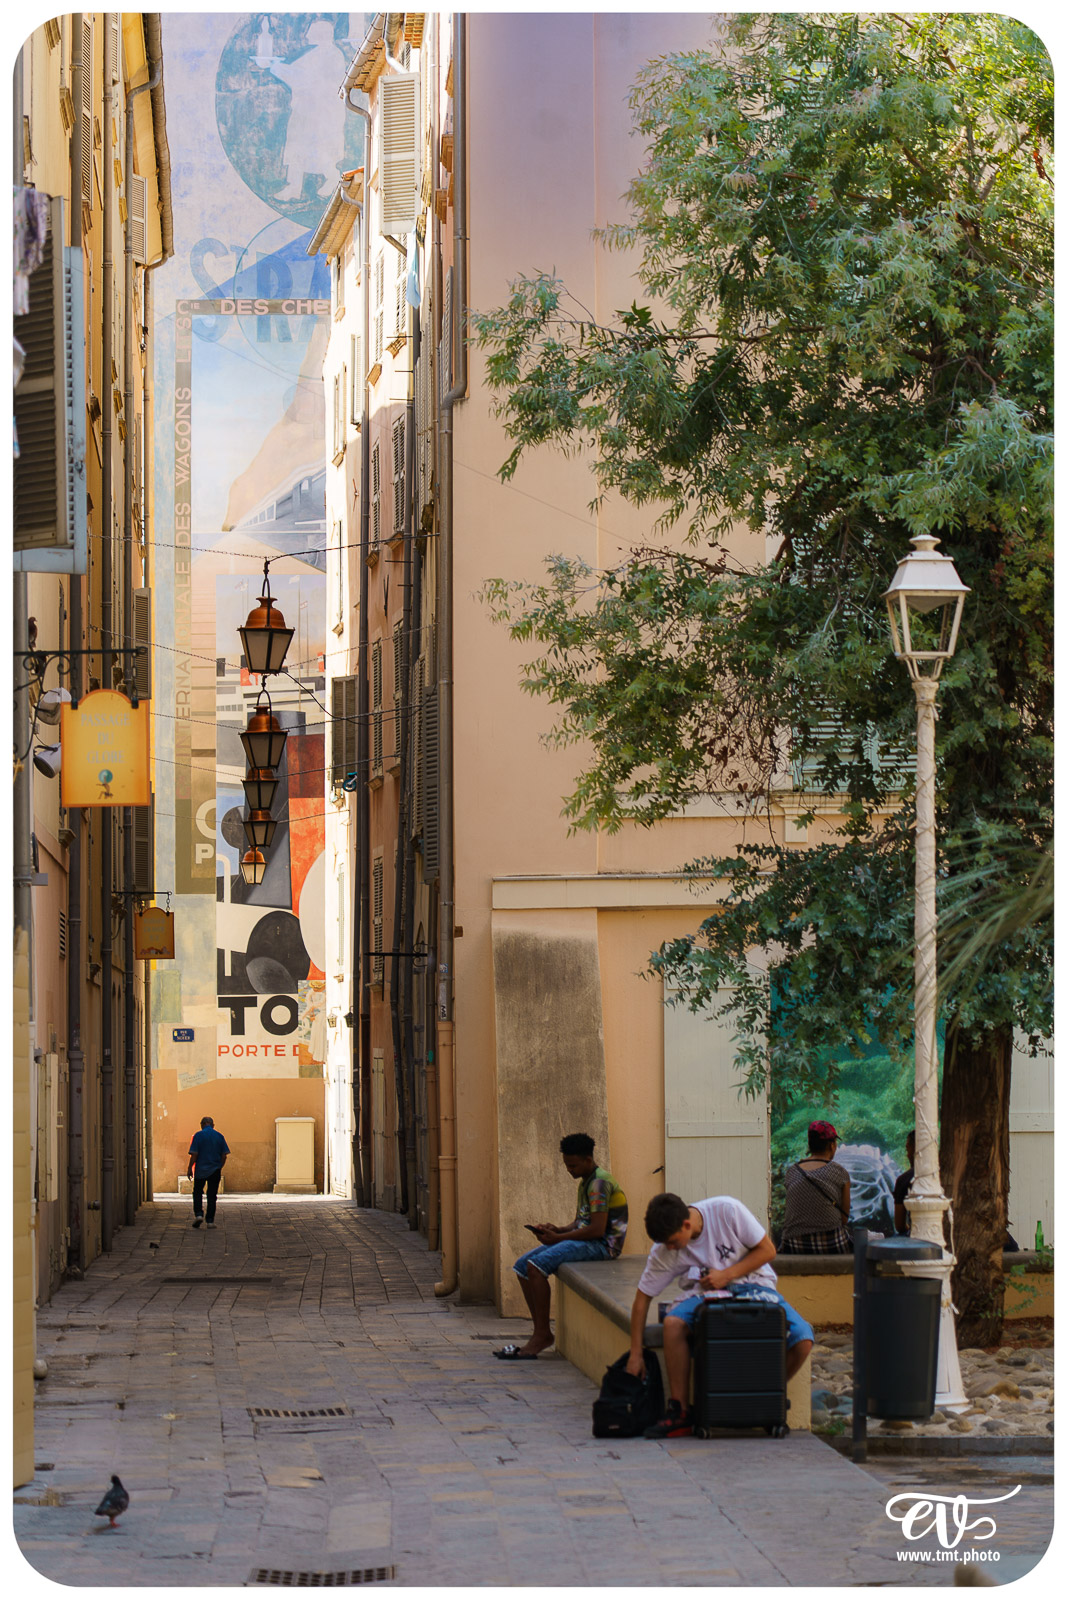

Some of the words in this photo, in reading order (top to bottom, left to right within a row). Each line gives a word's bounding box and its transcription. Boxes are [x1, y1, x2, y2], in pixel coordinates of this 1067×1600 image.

[220, 299, 269, 315] DES
[174, 387, 191, 487] WAGONS
[175, 502, 191, 546] DES
[175, 561, 191, 757] INTERNAIONALE
[80, 712, 131, 727] PASSAGE
[97, 731, 114, 745] DU
[86, 750, 126, 764] GLOBE
[218, 995, 298, 1036] TO
[218, 1044, 286, 1057] PORTE
